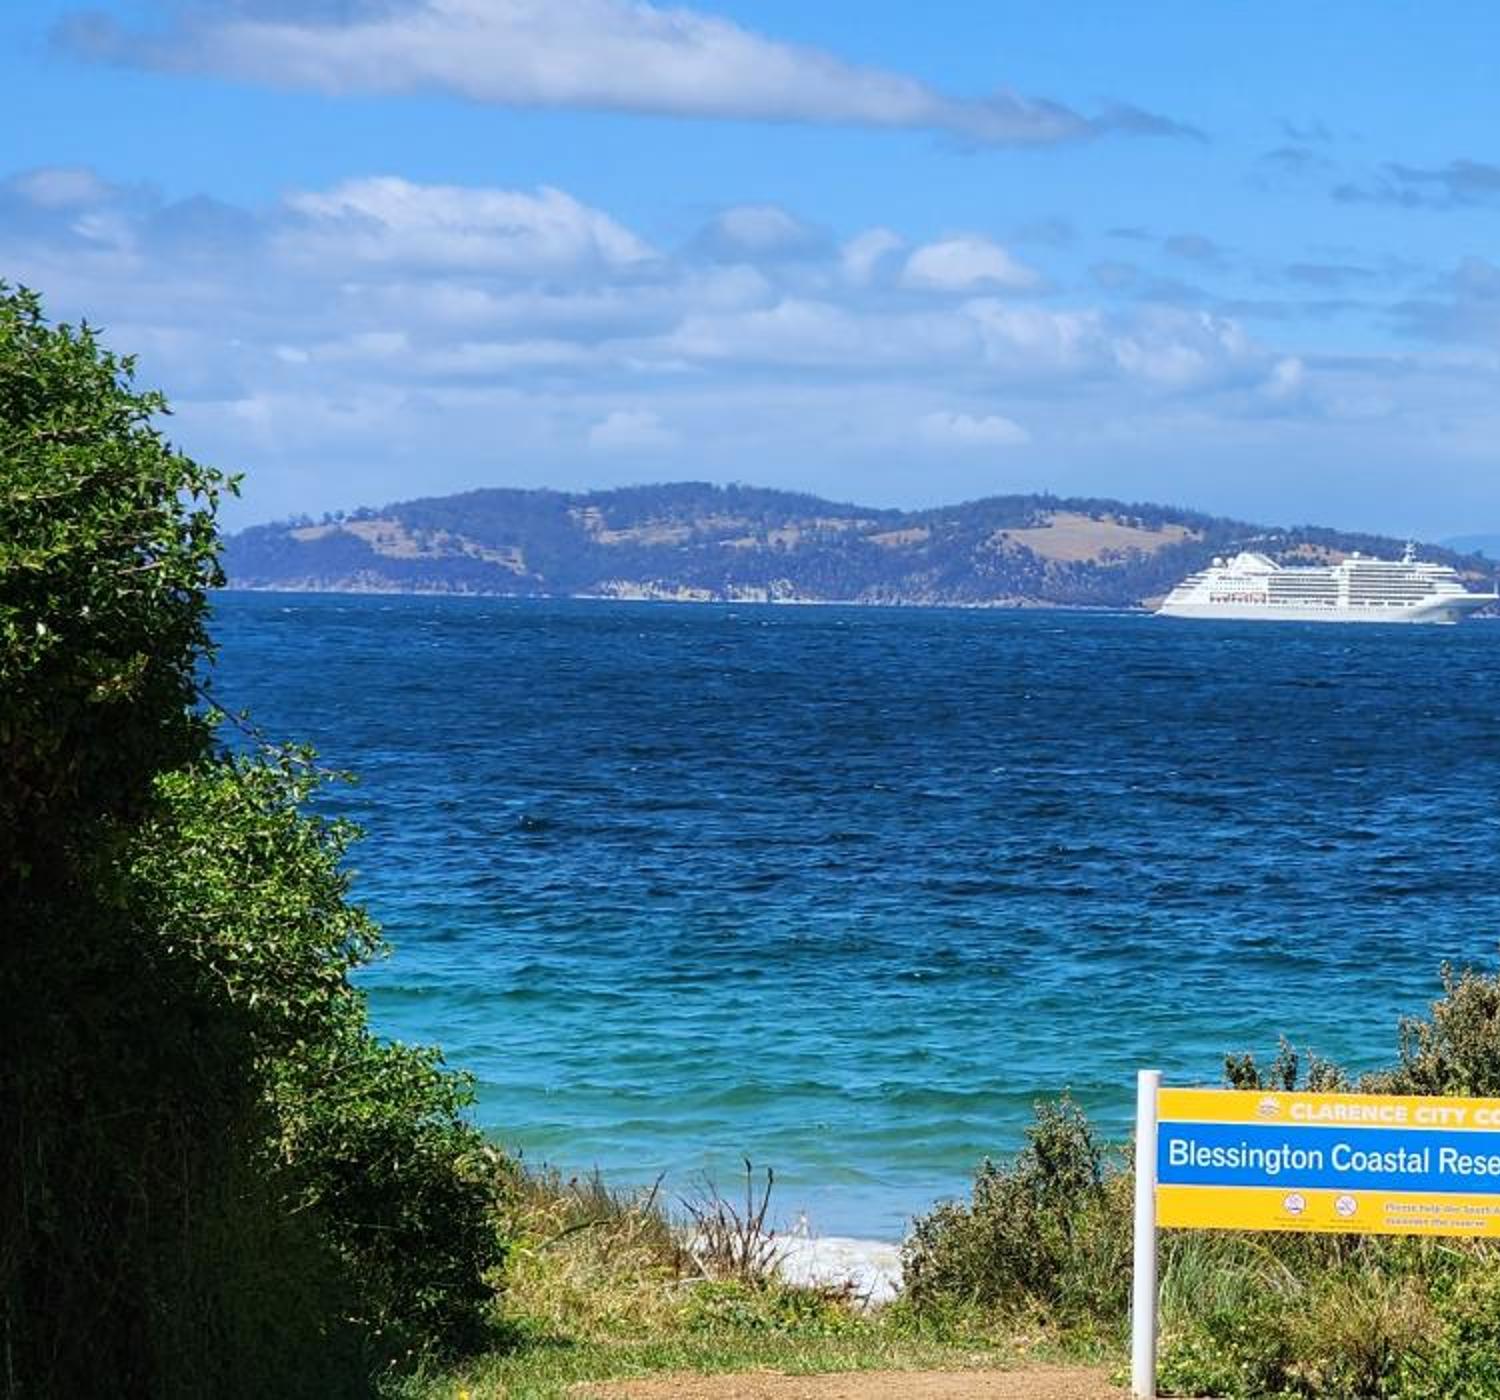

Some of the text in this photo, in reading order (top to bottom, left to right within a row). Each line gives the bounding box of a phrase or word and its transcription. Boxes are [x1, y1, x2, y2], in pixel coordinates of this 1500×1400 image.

[1290, 1103, 1408, 1122] CLARENCE
[1414, 1105, 1467, 1124] CITY
[1168, 1139, 1323, 1175] Blessington
[1331, 1143, 1430, 1174] Coastal
